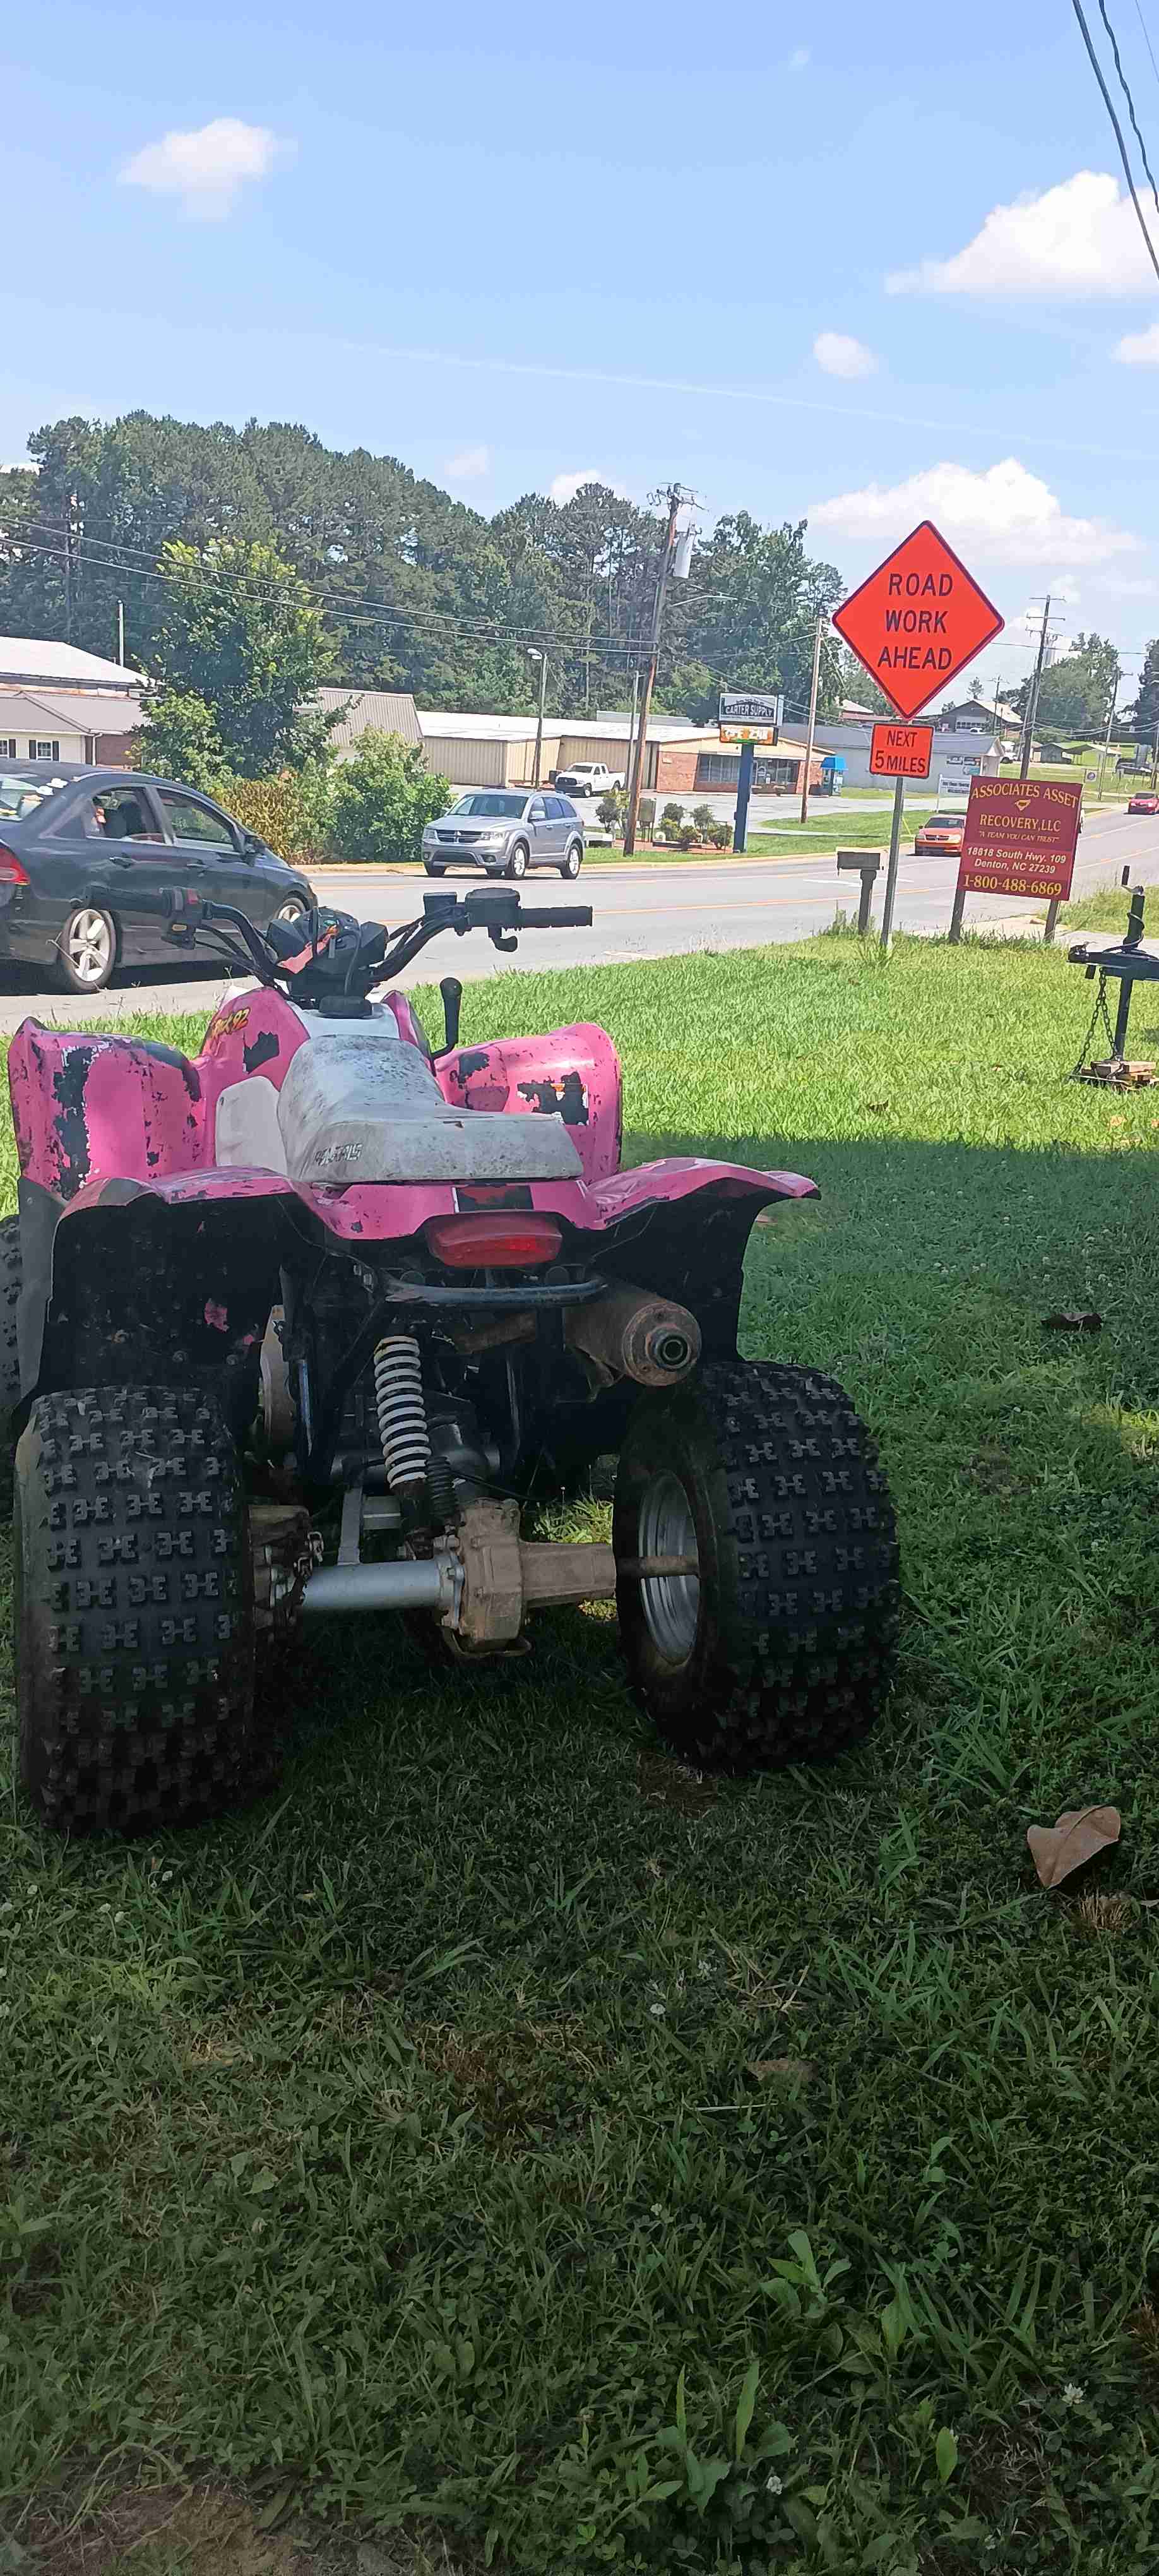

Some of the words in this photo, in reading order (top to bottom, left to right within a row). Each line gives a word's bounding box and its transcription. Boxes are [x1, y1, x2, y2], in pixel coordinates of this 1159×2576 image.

[888, 573, 953, 597] ROAD
[886, 609, 948, 633] WORK
[877, 646, 953, 670] AHEAD
[725, 704, 749, 715] CARTER
[886, 730, 918, 748] NEXT
[875, 749, 884, 769] 5
[886, 755, 926, 773] MILES
[971, 783, 1040, 799] ASSOCIATES
[1043, 787, 1078, 808] ASSET
[987, 831, 1005, 839] TEAM
[974, 858, 1009, 871] Denton,
[1028, 864, 1056, 874] 27239
[996, 849, 1023, 859] South
[1025, 852, 1047, 863] Hwy.
[1050, 855, 1066, 864] 109
[963, 874, 1062, 896] 1-800-488-6869
